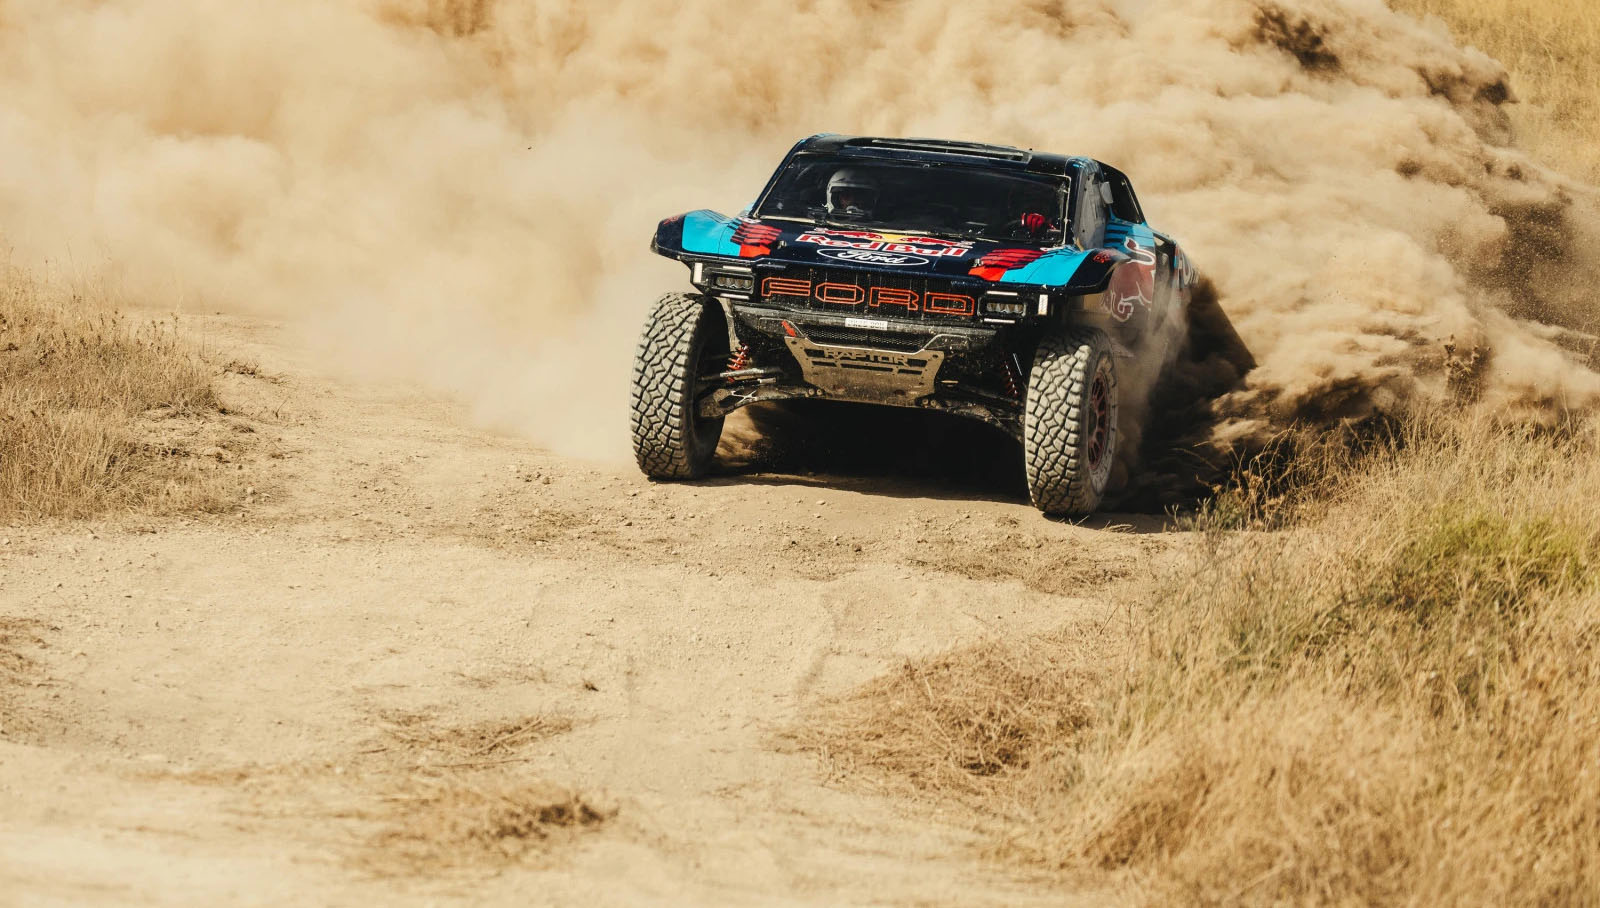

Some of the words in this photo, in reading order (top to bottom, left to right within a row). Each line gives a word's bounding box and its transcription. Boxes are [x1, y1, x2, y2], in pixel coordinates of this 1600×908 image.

[795, 233, 885, 250] Red
[882, 242, 969, 257] Bull
[837, 250, 905, 264] Ford
[761, 277, 975, 316] FORD
[824, 350, 911, 367] RAPTOR
